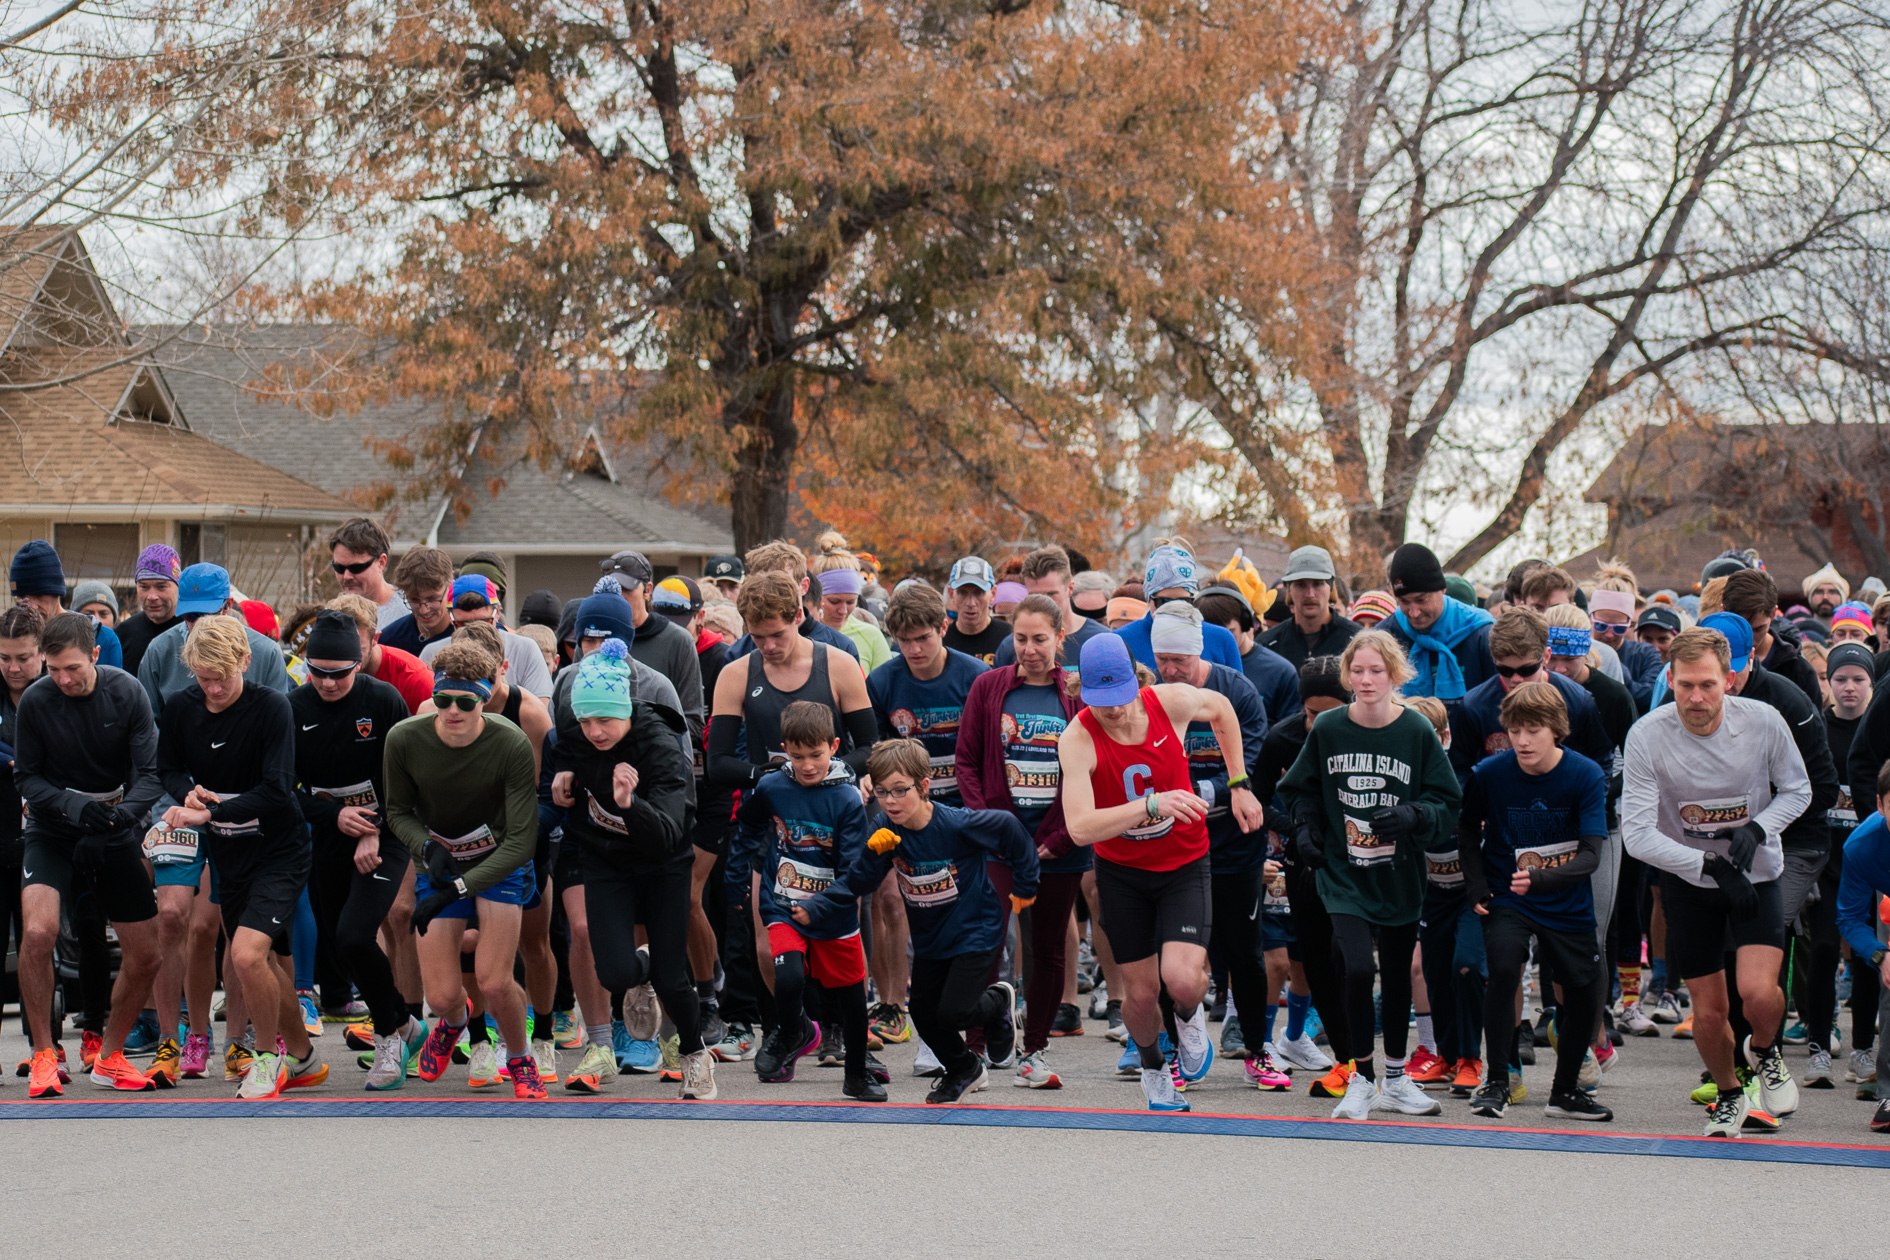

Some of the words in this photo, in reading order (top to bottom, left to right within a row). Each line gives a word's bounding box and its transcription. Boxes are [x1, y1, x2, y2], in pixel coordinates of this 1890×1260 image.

[1327, 753, 1373, 775] CATALINA
[1375, 754, 1411, 785] ISLAND
[1022, 773, 1057, 786] 1310
[1355, 779, 1377, 788] 1925
[1338, 788, 1377, 809] EMERALD
[1380, 793, 1400, 807] BAY
[1507, 811, 1569, 828] ROCKY
[1708, 806, 1748, 822] 2252
[161, 831, 197, 846] 1960
[917, 877, 951, 895] 1927
